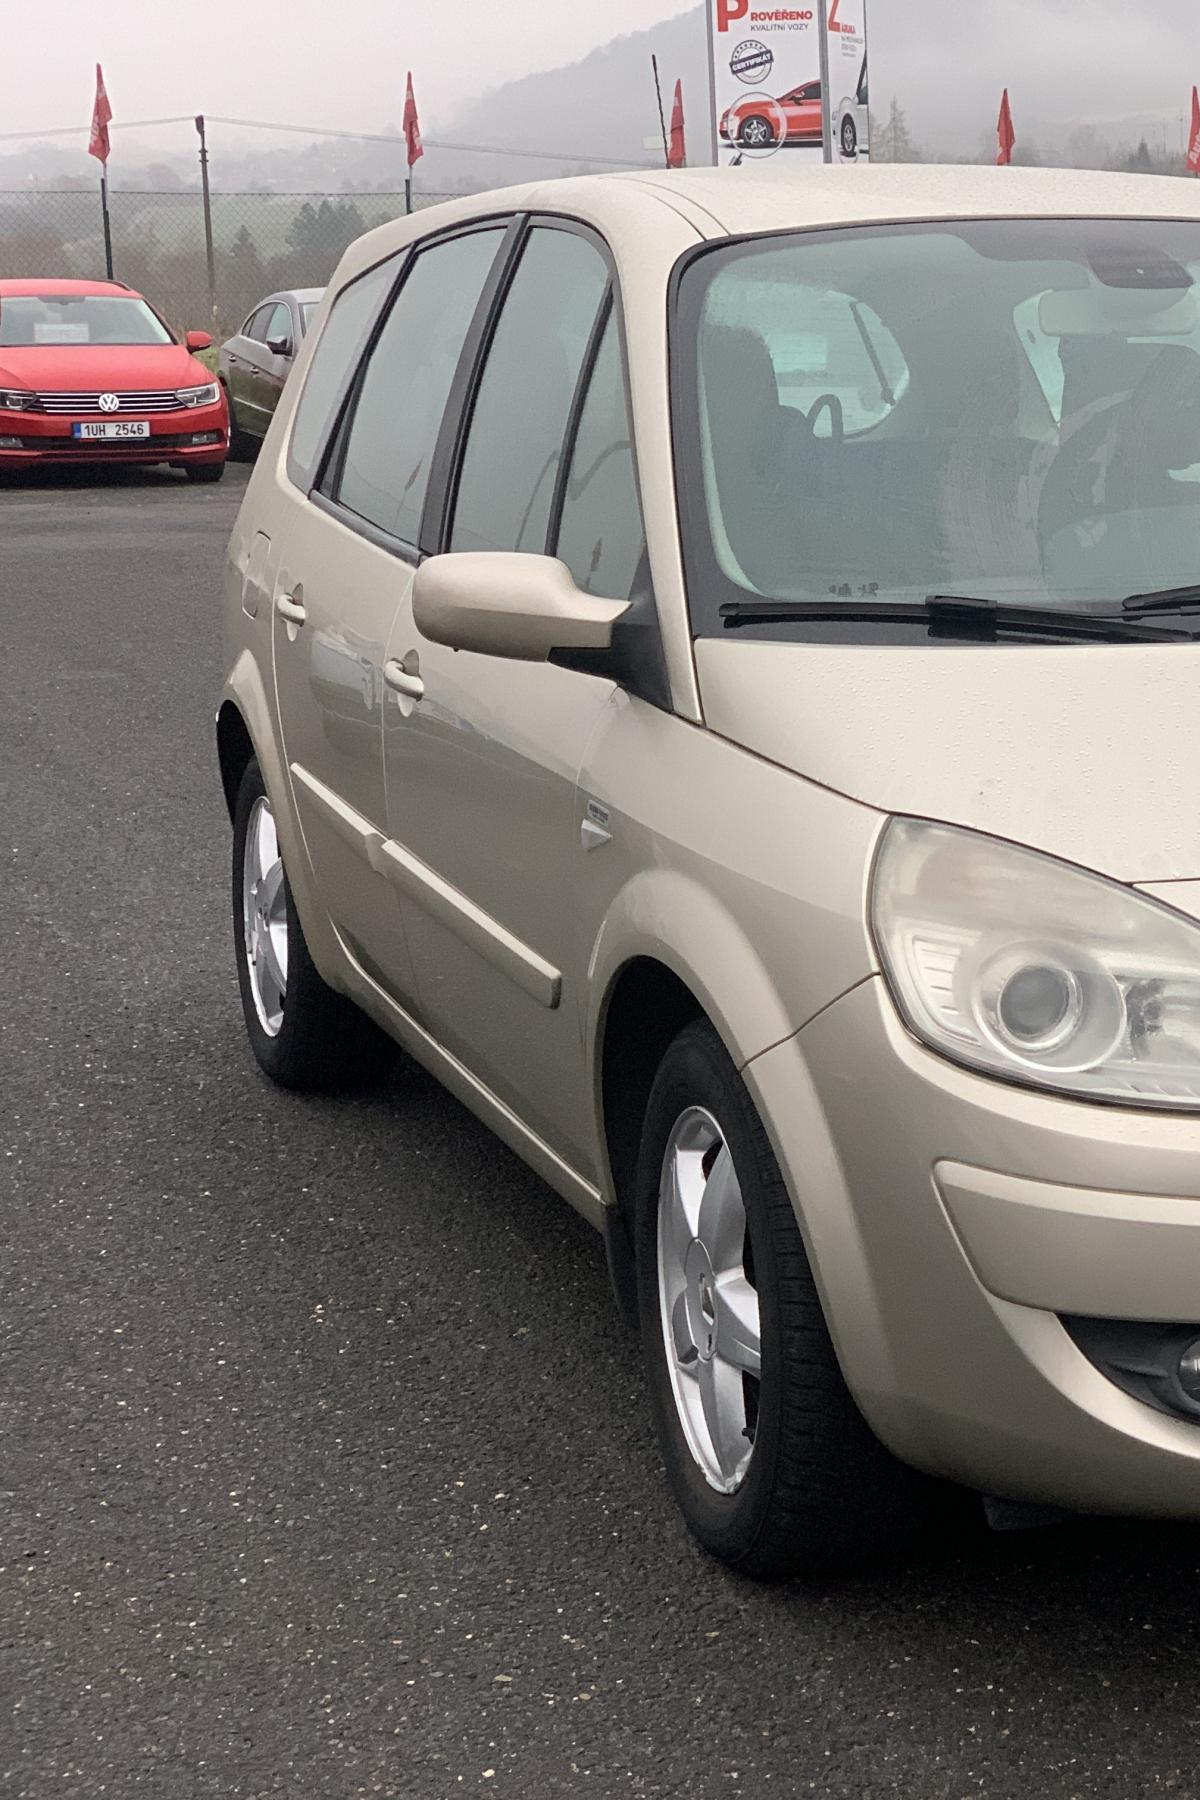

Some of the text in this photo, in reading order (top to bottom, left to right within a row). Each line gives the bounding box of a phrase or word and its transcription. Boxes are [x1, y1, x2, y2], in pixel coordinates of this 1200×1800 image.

[750, 23, 786, 31] KVALITNÍ
[84, 424, 106, 436] 1UH
[115, 424, 144, 435] 2546
